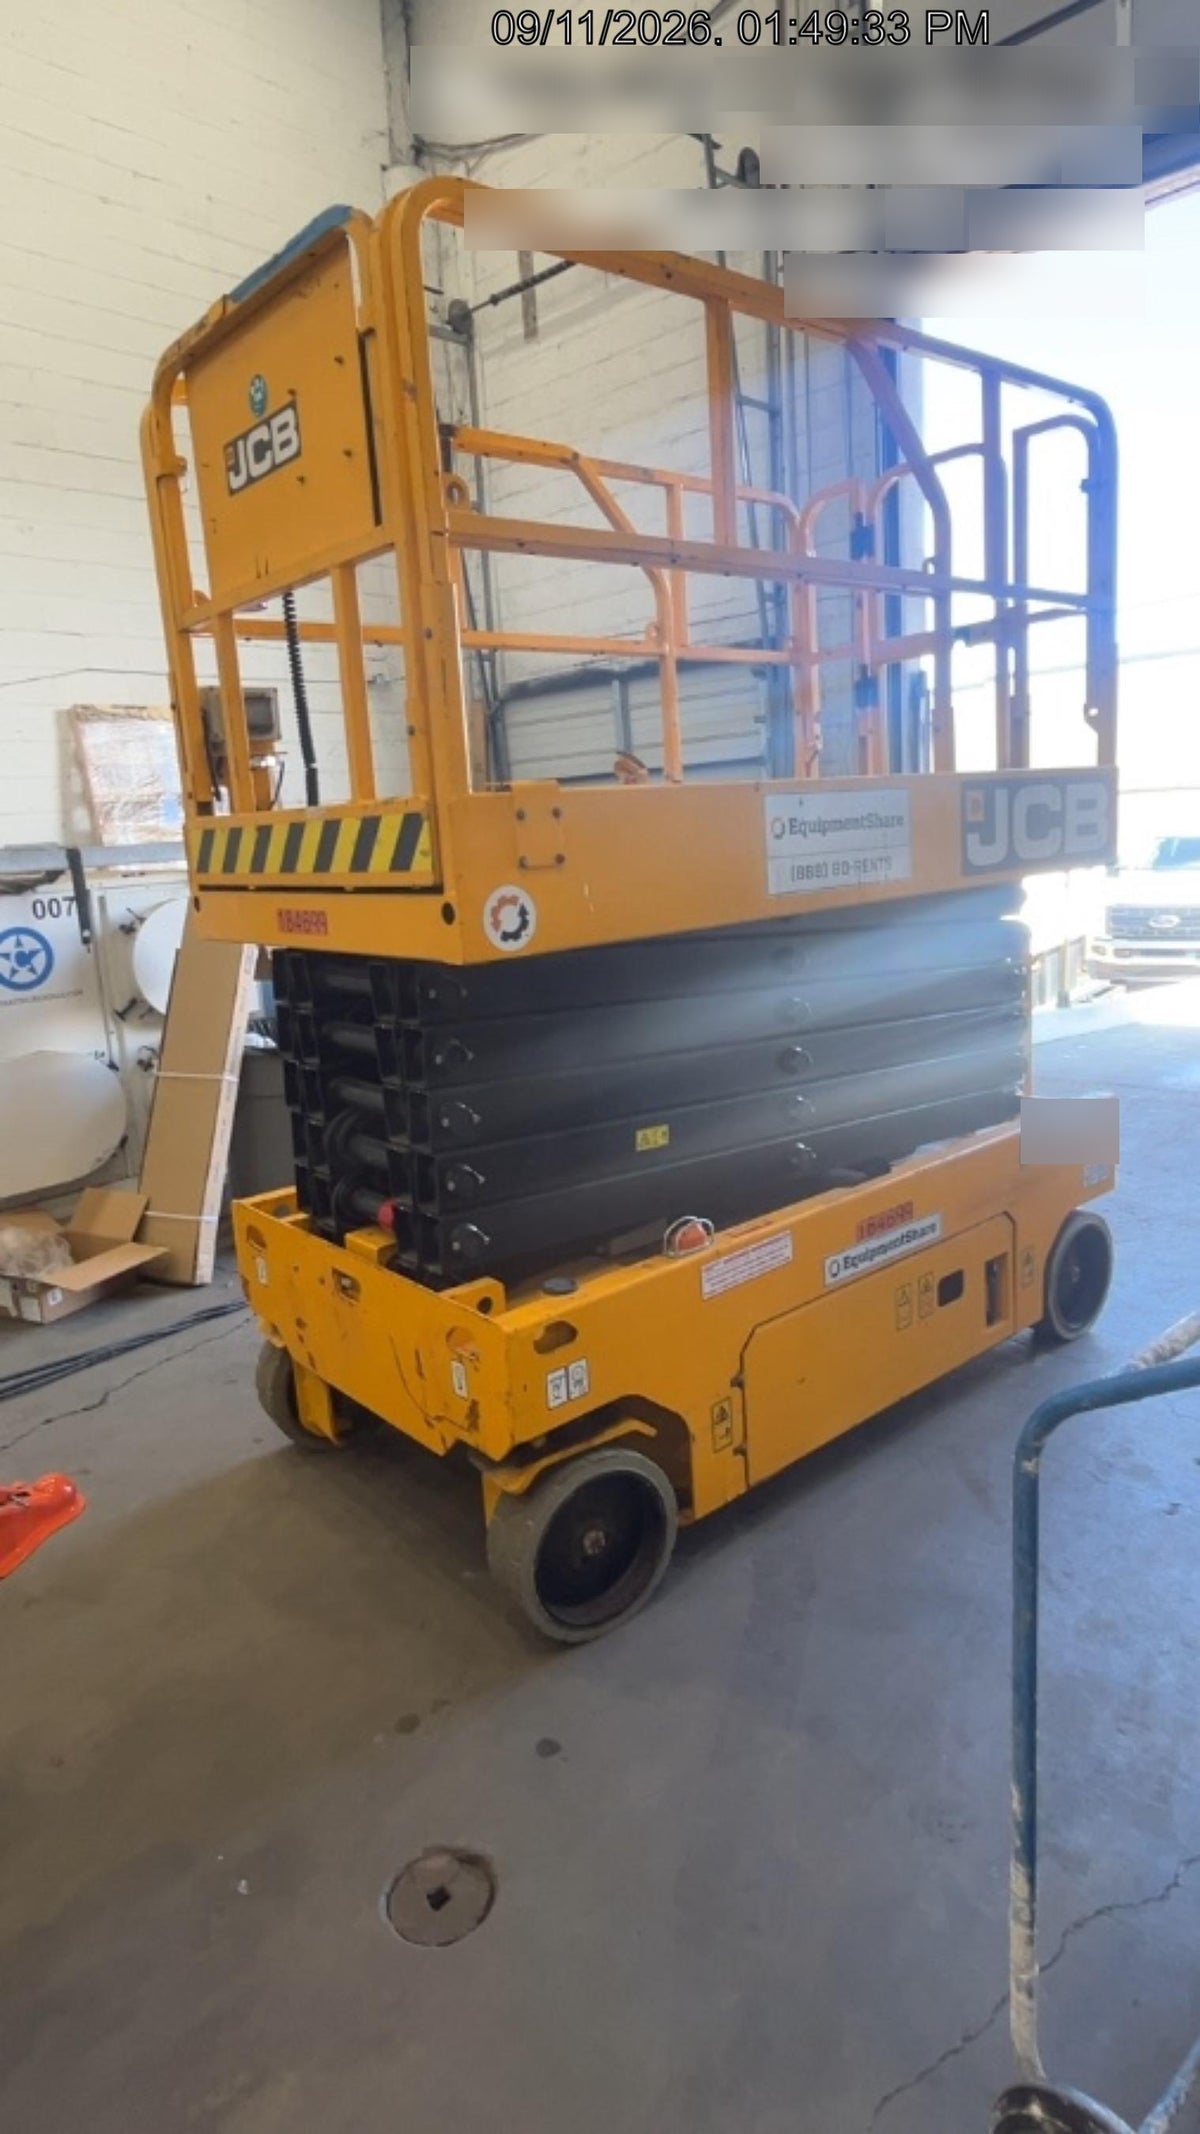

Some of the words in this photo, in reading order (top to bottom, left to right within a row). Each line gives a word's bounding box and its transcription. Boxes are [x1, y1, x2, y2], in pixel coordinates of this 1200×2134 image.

[229, 407, 300, 490] JCB
[789, 813, 904, 837] EquipmentShare
[966, 782, 1108, 867] JCB
[32, 896, 76, 919] 007
[844, 1222, 937, 1269] EquipmentShare
